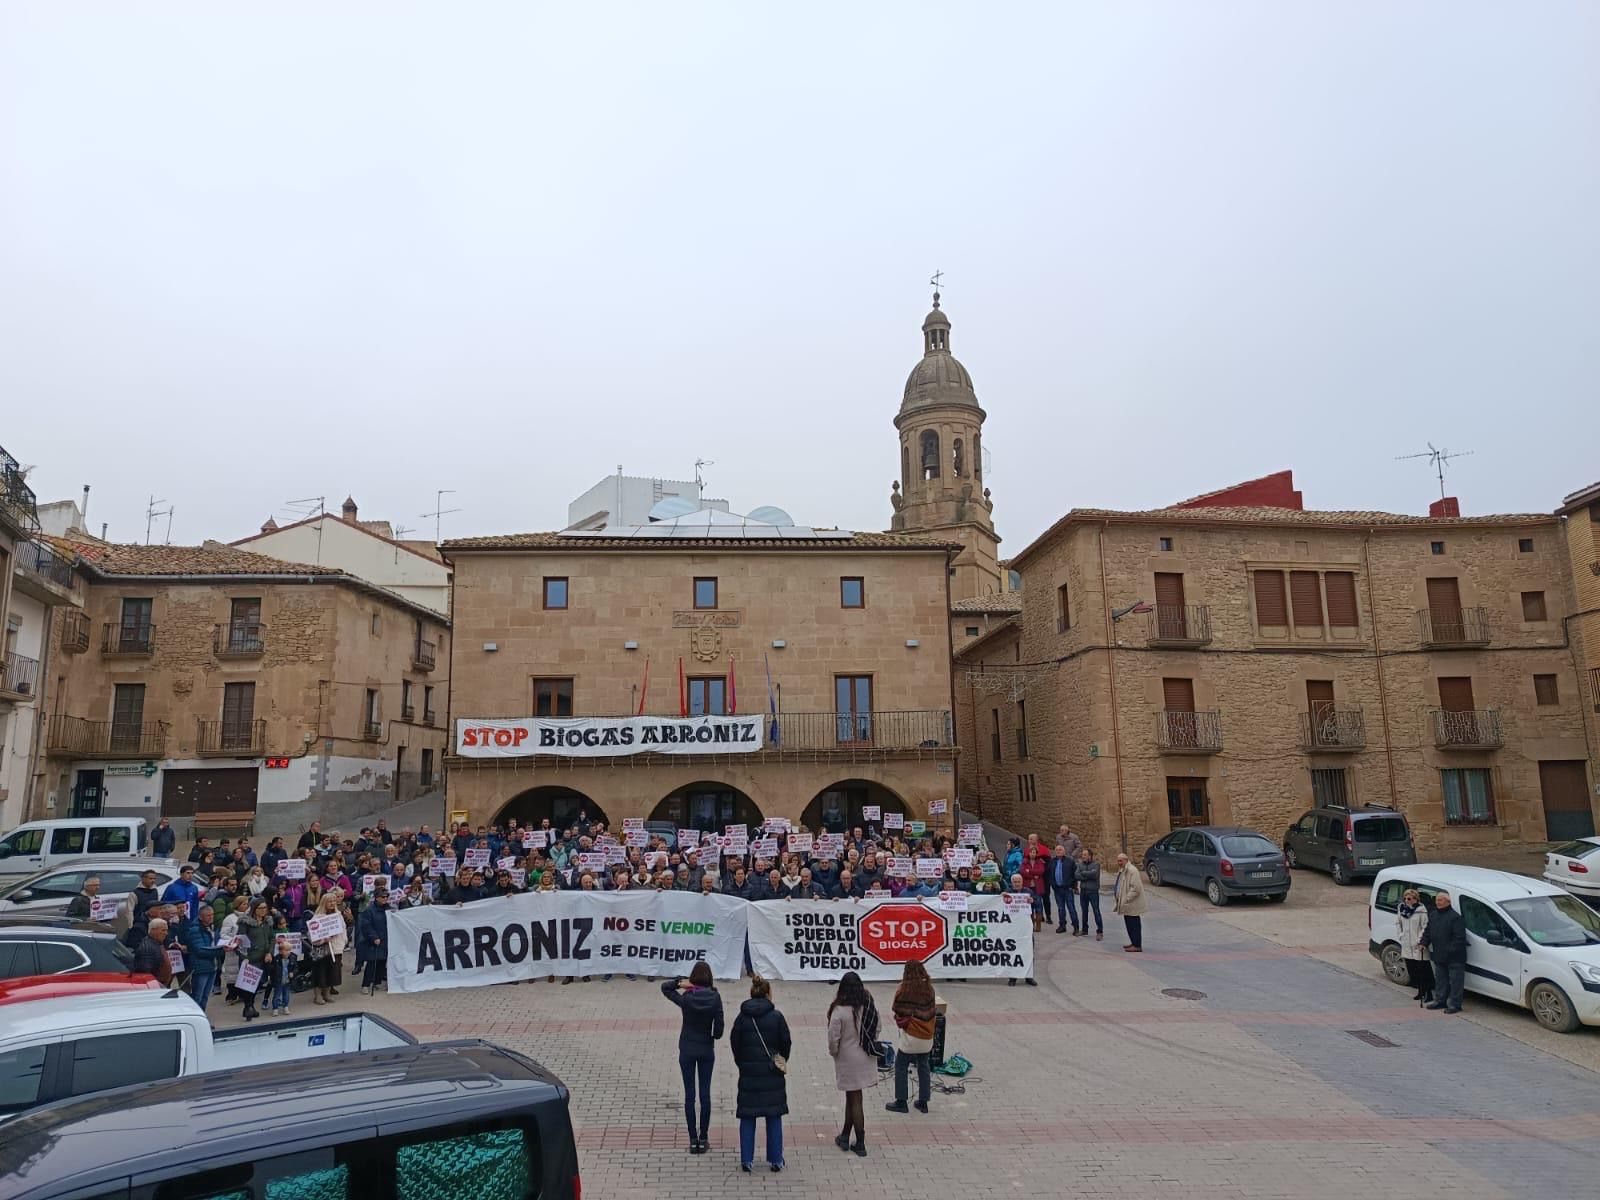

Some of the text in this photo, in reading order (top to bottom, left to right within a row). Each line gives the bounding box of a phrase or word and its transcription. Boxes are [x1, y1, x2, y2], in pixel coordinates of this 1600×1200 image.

[462, 727, 529, 747] STOP
[785, 913, 835, 927] ¡SOLO
[957, 910, 1012, 923] FUERA
[603, 917, 715, 936] NO SE VENDE
[868, 920, 937, 938] STOP
[953, 925, 987, 938] AGR
[793, 927, 856, 942] PUEBLO
[416, 917, 594, 974] ARRONIZ
[784, 942, 858, 956] SALVA AL
[879, 938, 928, 950] BIOGÁS
[952, 938, 1017, 952] BIOGAS
[600, 944, 707, 962] SE DEFIENDE
[799, 956, 866, 970] PUEBLO!
[942, 953, 1025, 968] KANPORA
